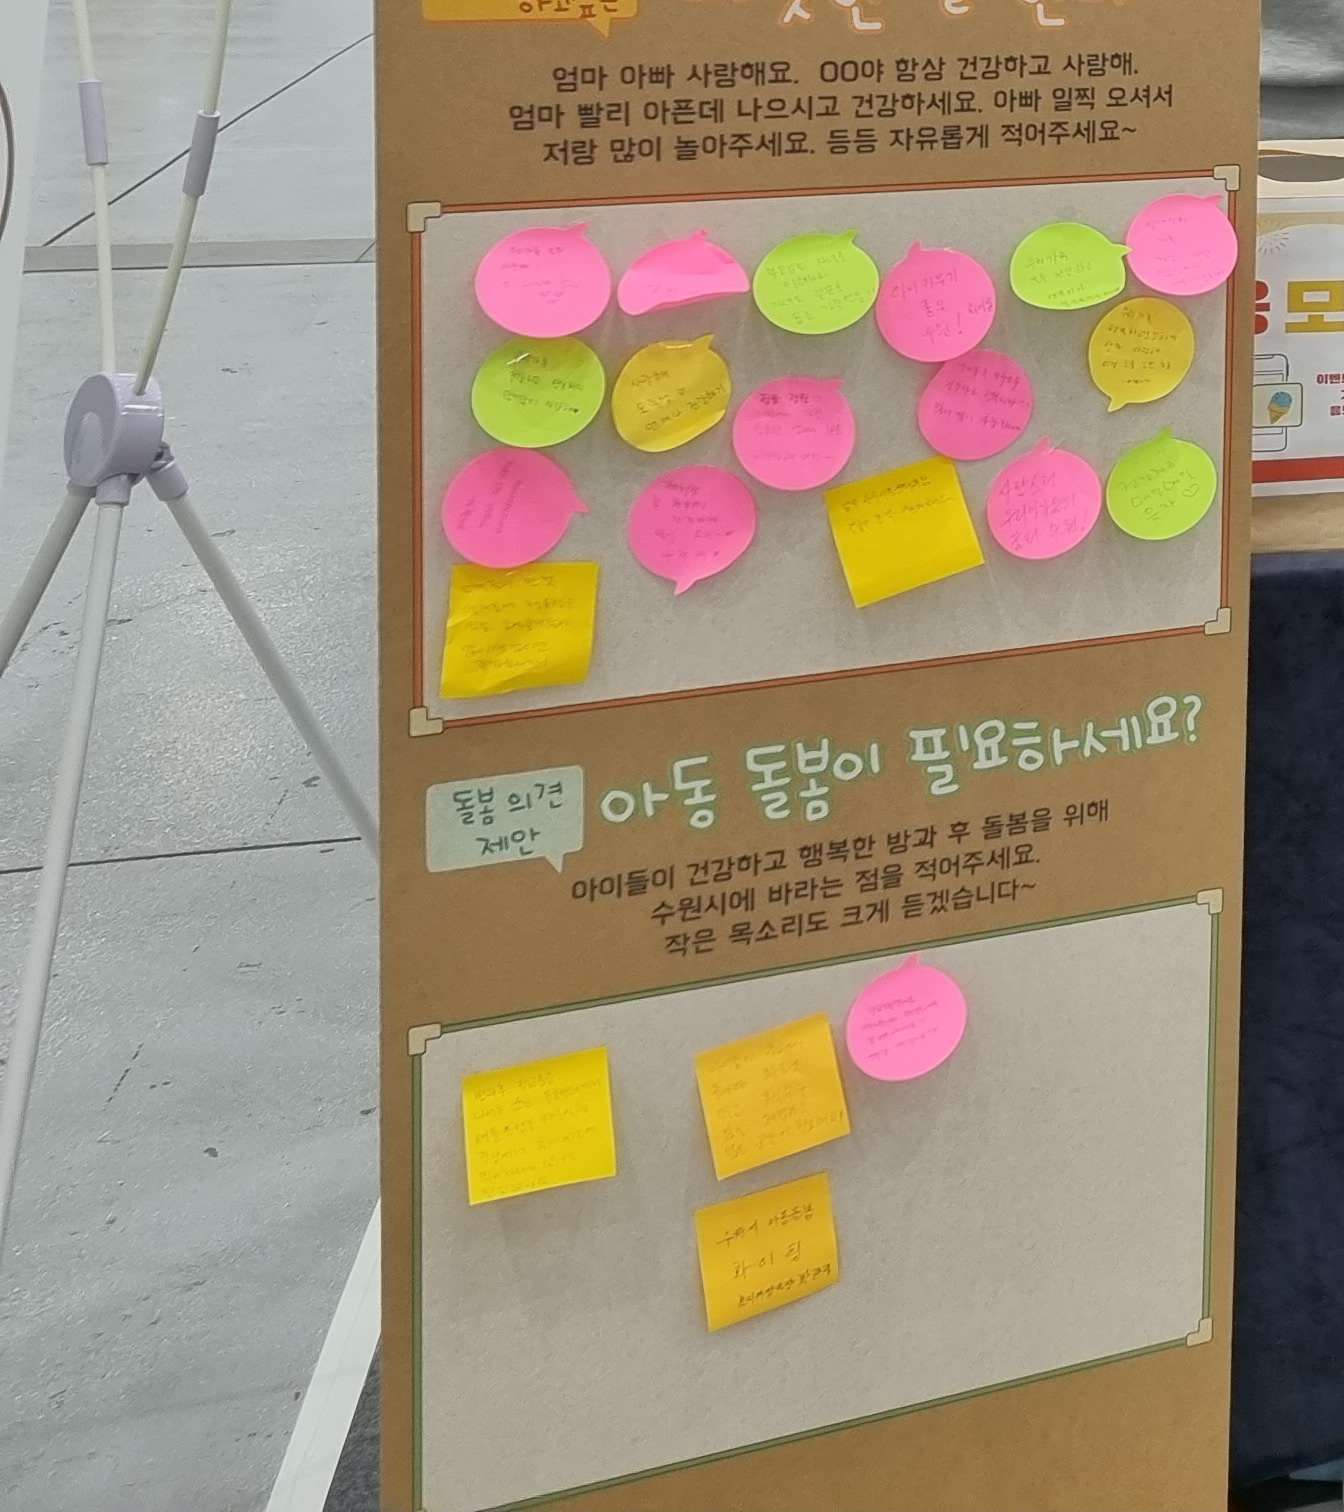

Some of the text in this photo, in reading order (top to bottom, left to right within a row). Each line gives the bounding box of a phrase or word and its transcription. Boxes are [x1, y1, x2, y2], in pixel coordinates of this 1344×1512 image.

[552, 64, 608, 93] 엄마
[620, 63, 674, 90] 아빠
[687, 61, 799, 88] 사랑해요.
[895, 57, 946, 82] 항상
[957, 55, 1050, 81] 건강하고
[1063, 52, 1139, 77] 사랑해.
[509, 84, 1174, 131] 엄마 빨리 아픈데 나으시고 건강하세요. 아빠 일찍 오셔서
[543, 119, 1137, 166] 저랑 많이 놀아주세요. 등등 자유롭게 적어주세요~
[601, 695, 1202, 829] 아동 돌봄이 필요하세요?
[453, 781, 563, 826] 돌봄 의견
[476, 828, 540, 856] 제안
[571, 799, 1110, 902] 아이들이 건강하고 행복한 방과 후 돌봄을 위해
[651, 843, 1040, 926] 수원시에 바라는 점을 적어주세요.
[665, 879, 1036, 958] 작은 목소리도 크게 듣겠습니다~
